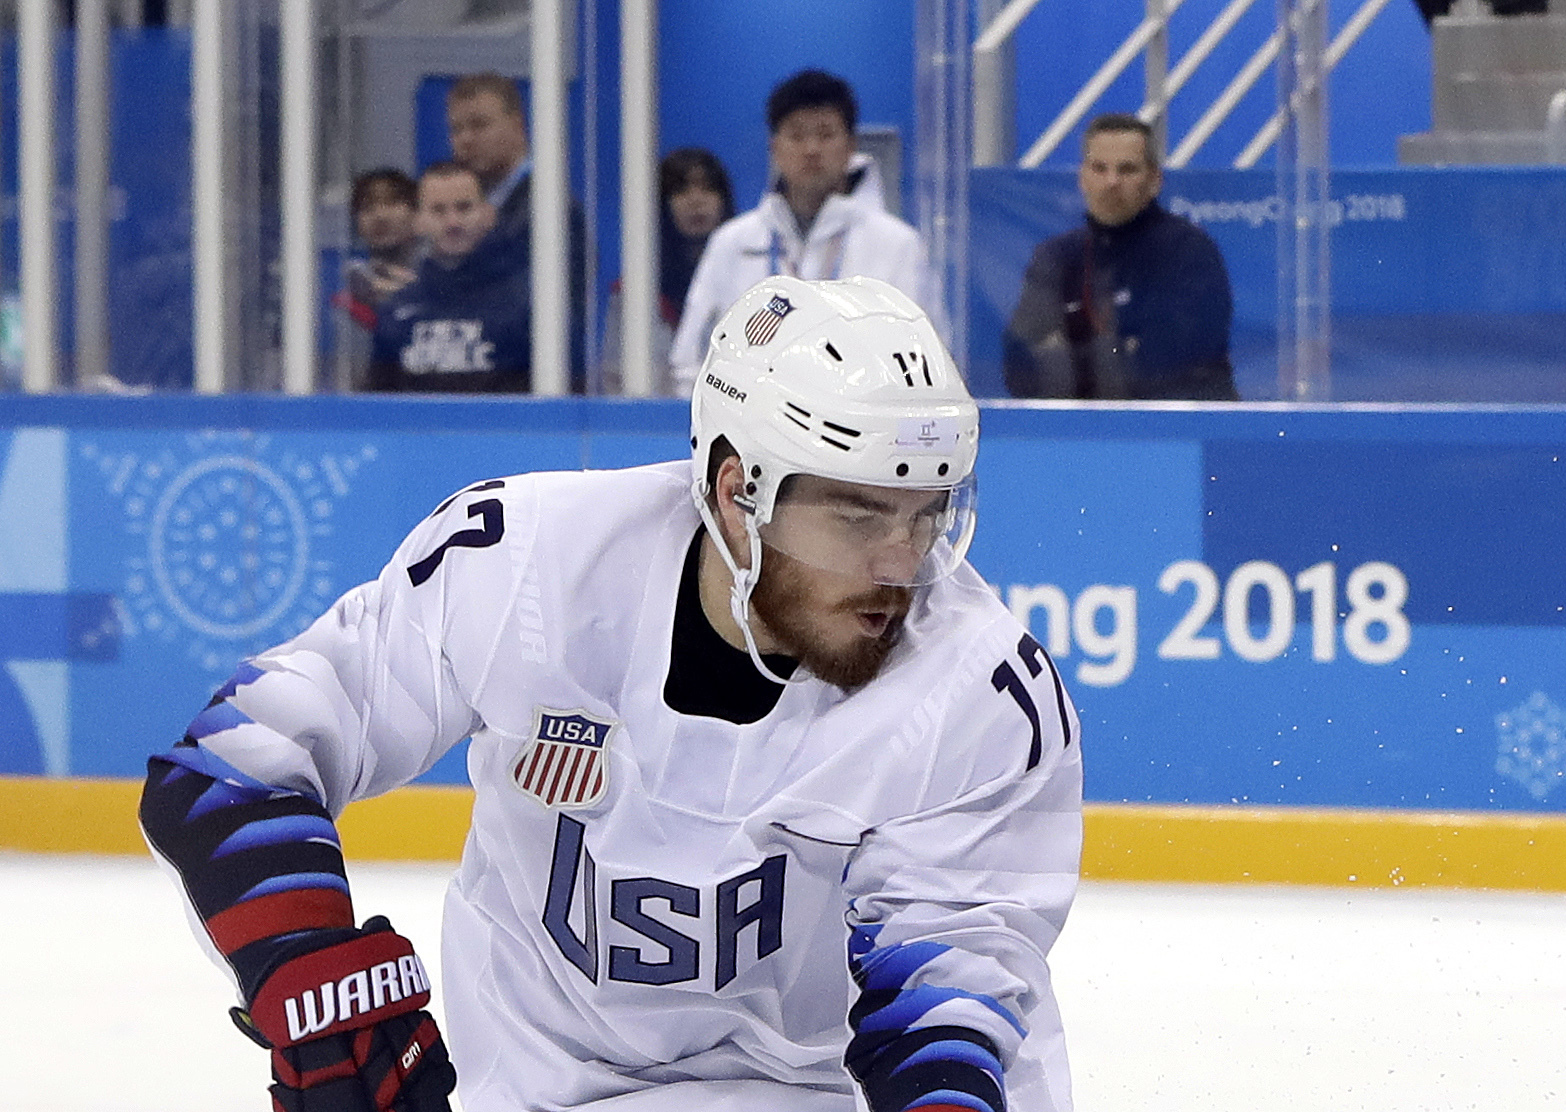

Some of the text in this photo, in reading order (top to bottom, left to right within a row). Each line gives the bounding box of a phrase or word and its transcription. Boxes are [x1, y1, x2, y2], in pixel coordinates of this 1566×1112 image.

[769, 297, 789, 316] USA
[1157, 559, 1411, 665] 2018
[546, 718, 597, 743] USA
[541, 811, 787, 992] USA
